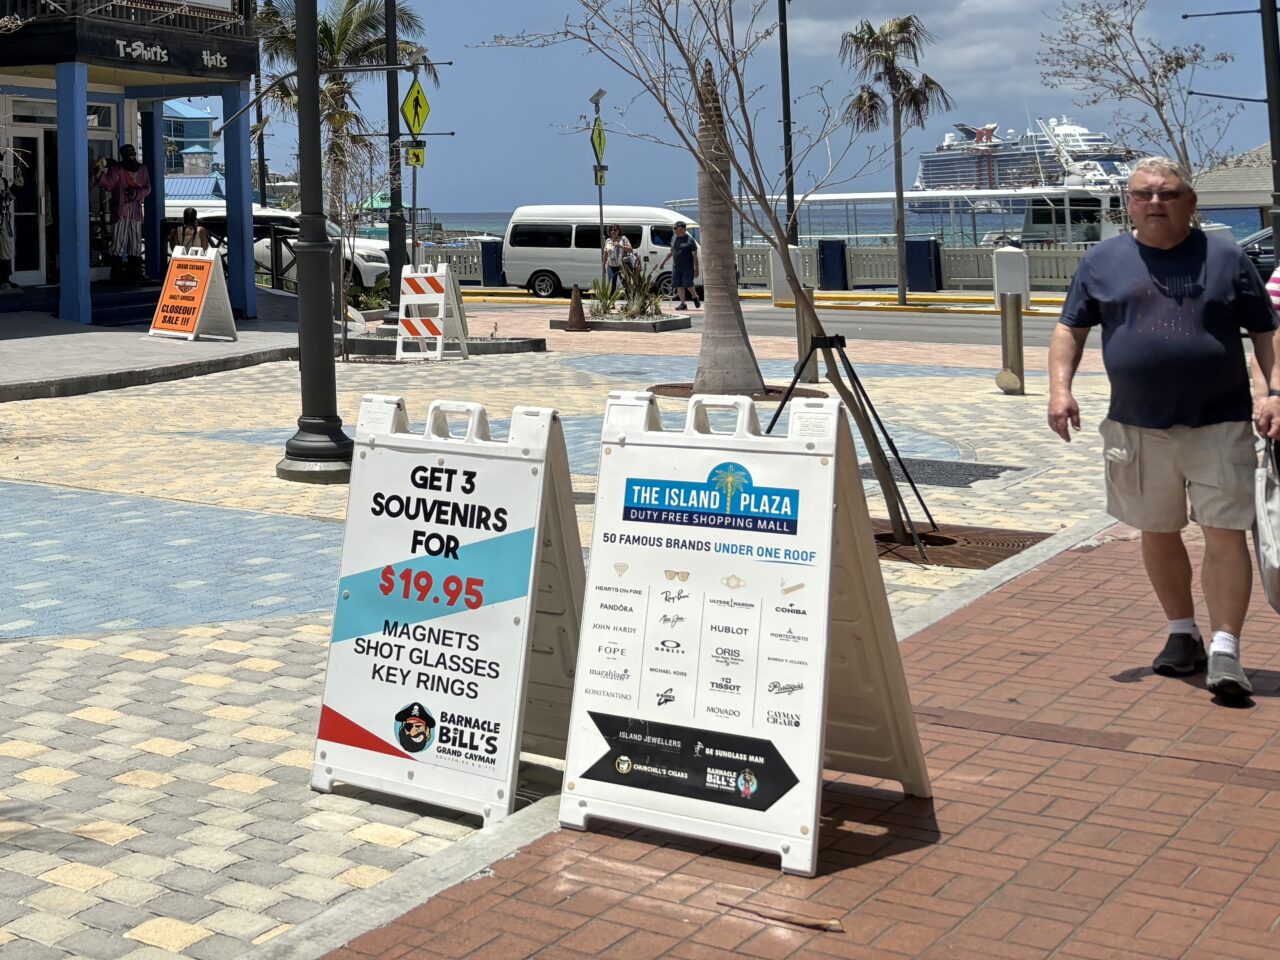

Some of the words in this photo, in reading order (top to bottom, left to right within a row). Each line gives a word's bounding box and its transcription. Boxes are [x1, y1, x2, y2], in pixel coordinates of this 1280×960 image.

[115, 39, 169, 62] T-Shirts
[201, 49, 227, 68] Hats
[161, 304, 197, 316] CLOSEOUT
[161, 315, 180, 325] SALE
[180, 317, 190, 326] !!!
[411, 465, 458, 492] GET
[461, 470, 477, 494] 3
[632, 486, 660, 505] THE
[664, 488, 720, 509] ISLAND
[740, 493, 792, 515] PLAZA
[370, 492, 508, 532] SOUVENIRS
[630, 509, 659, 520] DUTY
[662, 511, 689, 523] FREE
[692, 513, 753, 529] SHOPPING
[757, 519, 789, 532] MALL
[411, 530, 460, 560] FOR
[603, 532, 616, 544] 50
[619, 534, 663, 548] FAMOUS
[665, 537, 711, 552] BRANDS
[714, 543, 753, 556] UNDER
[756, 546, 781, 559] ONE
[784, 548, 817, 562] ROOF
[379, 565, 485, 609] $19.95
[595, 585, 619, 593] HEARTS
[733, 601, 755, 609] NARDIN
[775, 606, 807, 615] COHIBA
[382, 619, 480, 651] MAGNETS
[592, 623, 610, 631] JOHN
[613, 623, 638, 634] HARDY
[710, 624, 749, 635] HUBLOT
[770, 632, 809, 642] MONTECRISTO
[598, 645, 628, 656] FOPE
[655, 646, 686, 655] OAKLEY
[715, 647, 740, 658] ORIS
[353, 637, 406, 661] SHOT
[409, 647, 500, 679] GLASSES
[649, 667, 672, 675] MICHAEL
[371, 663, 412, 686] KEY
[416, 671, 479, 699] RINGS
[710, 681, 742, 692] TISSOT
[584, 687, 632, 701] KONSTANTINO
[706, 705, 741, 717] MOVADO
[767, 709, 801, 721] CAYMAN
[440, 711, 501, 734] BARNACLE
[619, 731, 643, 741] ISLAND
[643, 735, 681, 748] JEWELLERS
[436, 746, 462, 757] GRAND
[464, 752, 496, 765] CAYMAN
[715, 749, 747, 761] SUNGLASS
[748, 754, 764, 764] MAN
[633, 763, 667, 775] CHURCHILL'S
[667, 770, 688, 779] CIGARS
[706, 767, 737, 778] BARNACLE
